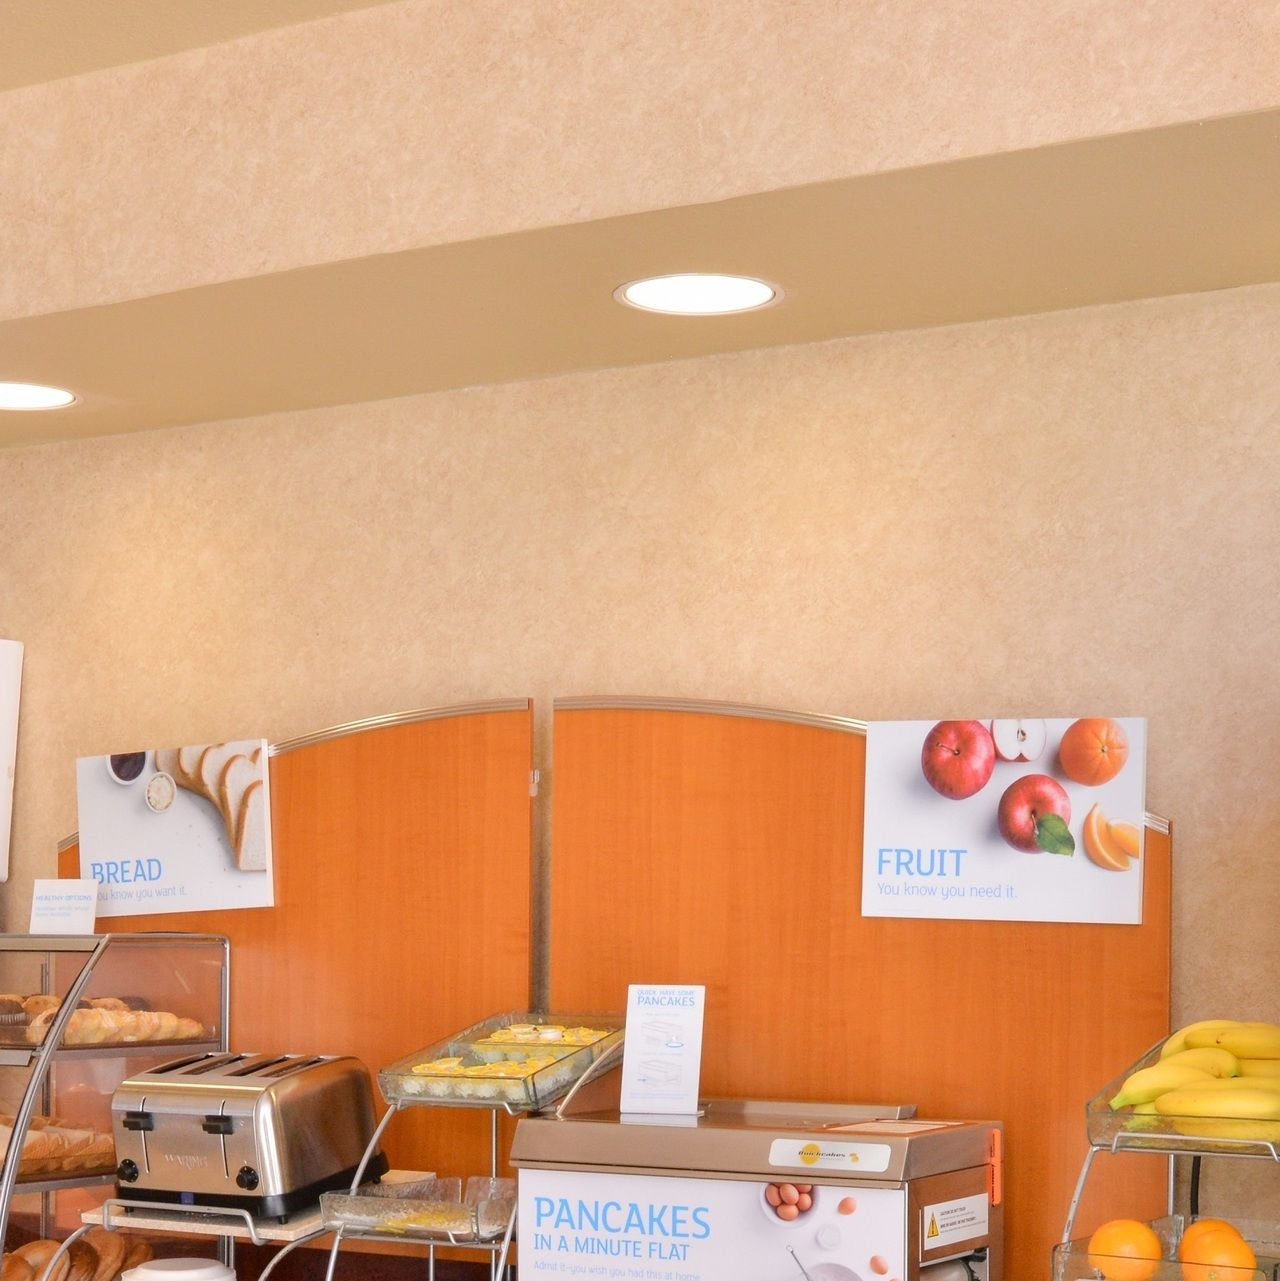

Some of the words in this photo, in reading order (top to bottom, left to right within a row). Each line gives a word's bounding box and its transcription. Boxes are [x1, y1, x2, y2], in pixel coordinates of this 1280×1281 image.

[91, 858, 162, 884] BREAD
[877, 848, 968, 877] FRUIT
[96, 892, 108, 900] ou
[110, 889, 135, 900] know
[136, 889, 153, 901] you
[155, 887, 176, 896] want
[877, 882, 900, 896] You
[904, 882, 937, 897] know
[941, 885, 965, 900] you
[969, 884, 1002, 898] need
[1006, 885, 1018, 898] it.
[637, 996, 696, 1007] PANCAKES
[534, 1196, 711, 1240] PANCAKES
[534, 1233, 552, 1251] IN
[558, 1235, 569, 1252] A
[575, 1236, 642, 1258] MINUTE
[648, 1241, 690, 1261] FLAT
[534, 1261, 557, 1271] Admit
[588, 1265, 608, 1275] wish
[609, 1267, 625, 1278] you
[627, 1267, 644, 1279] had
[646, 1268, 662, 1280] this
[662, 1271, 673, 1280] at
